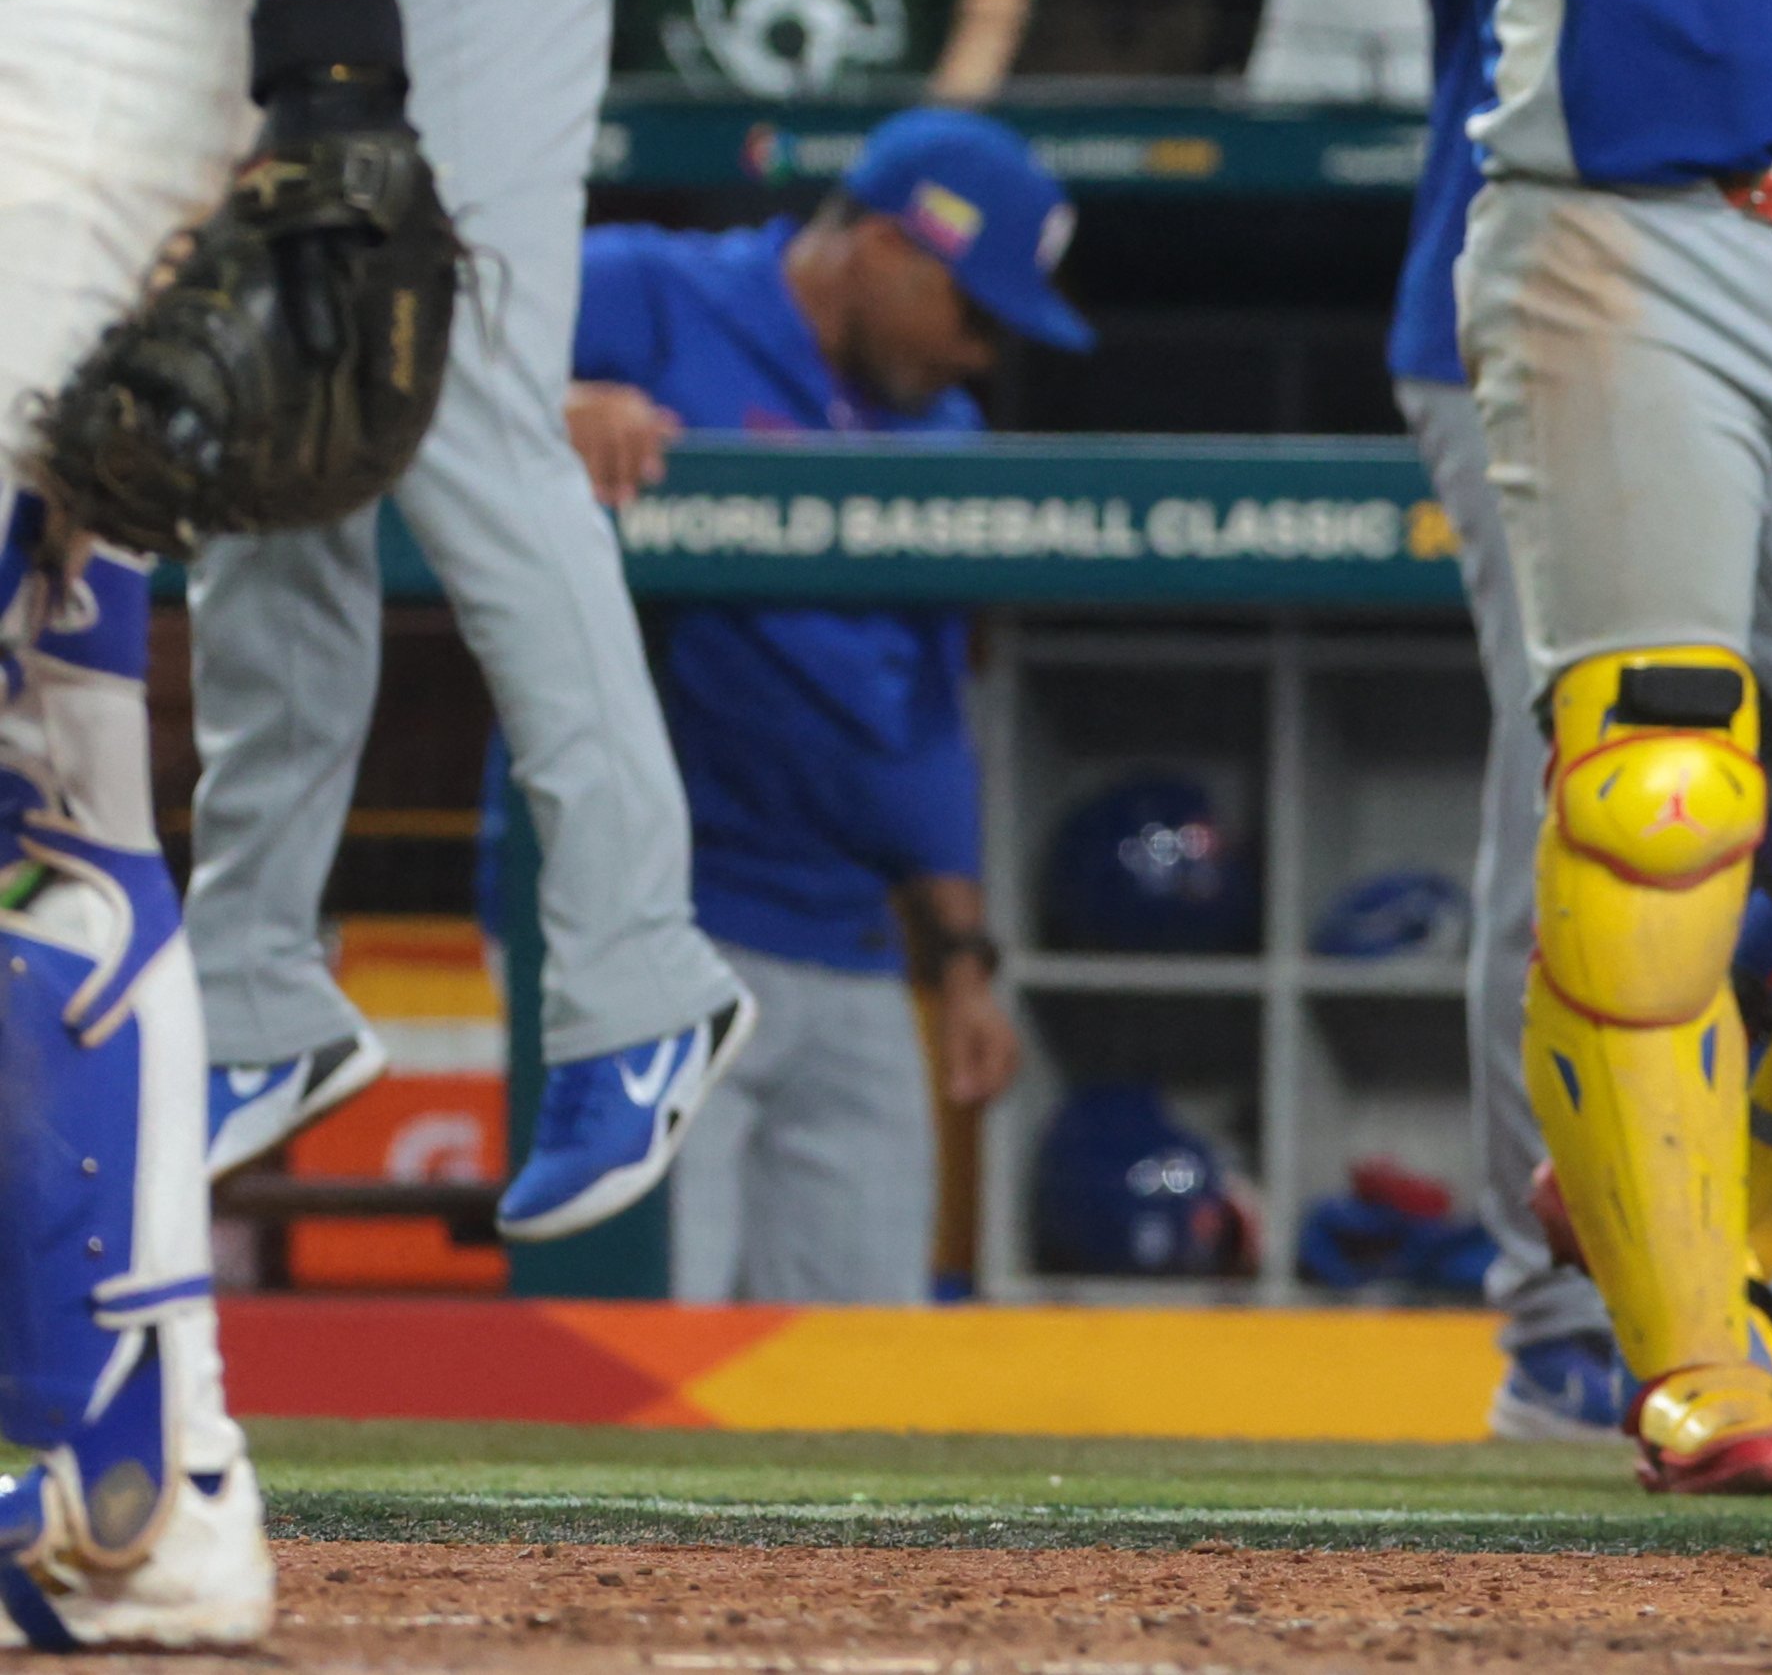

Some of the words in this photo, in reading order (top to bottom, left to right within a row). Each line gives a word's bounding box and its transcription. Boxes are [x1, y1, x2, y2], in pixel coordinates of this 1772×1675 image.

[620, 495, 836, 556] WORLD
[840, 495, 1143, 558] BASEBALL
[1145, 497, 1400, 560] CLASSIC
